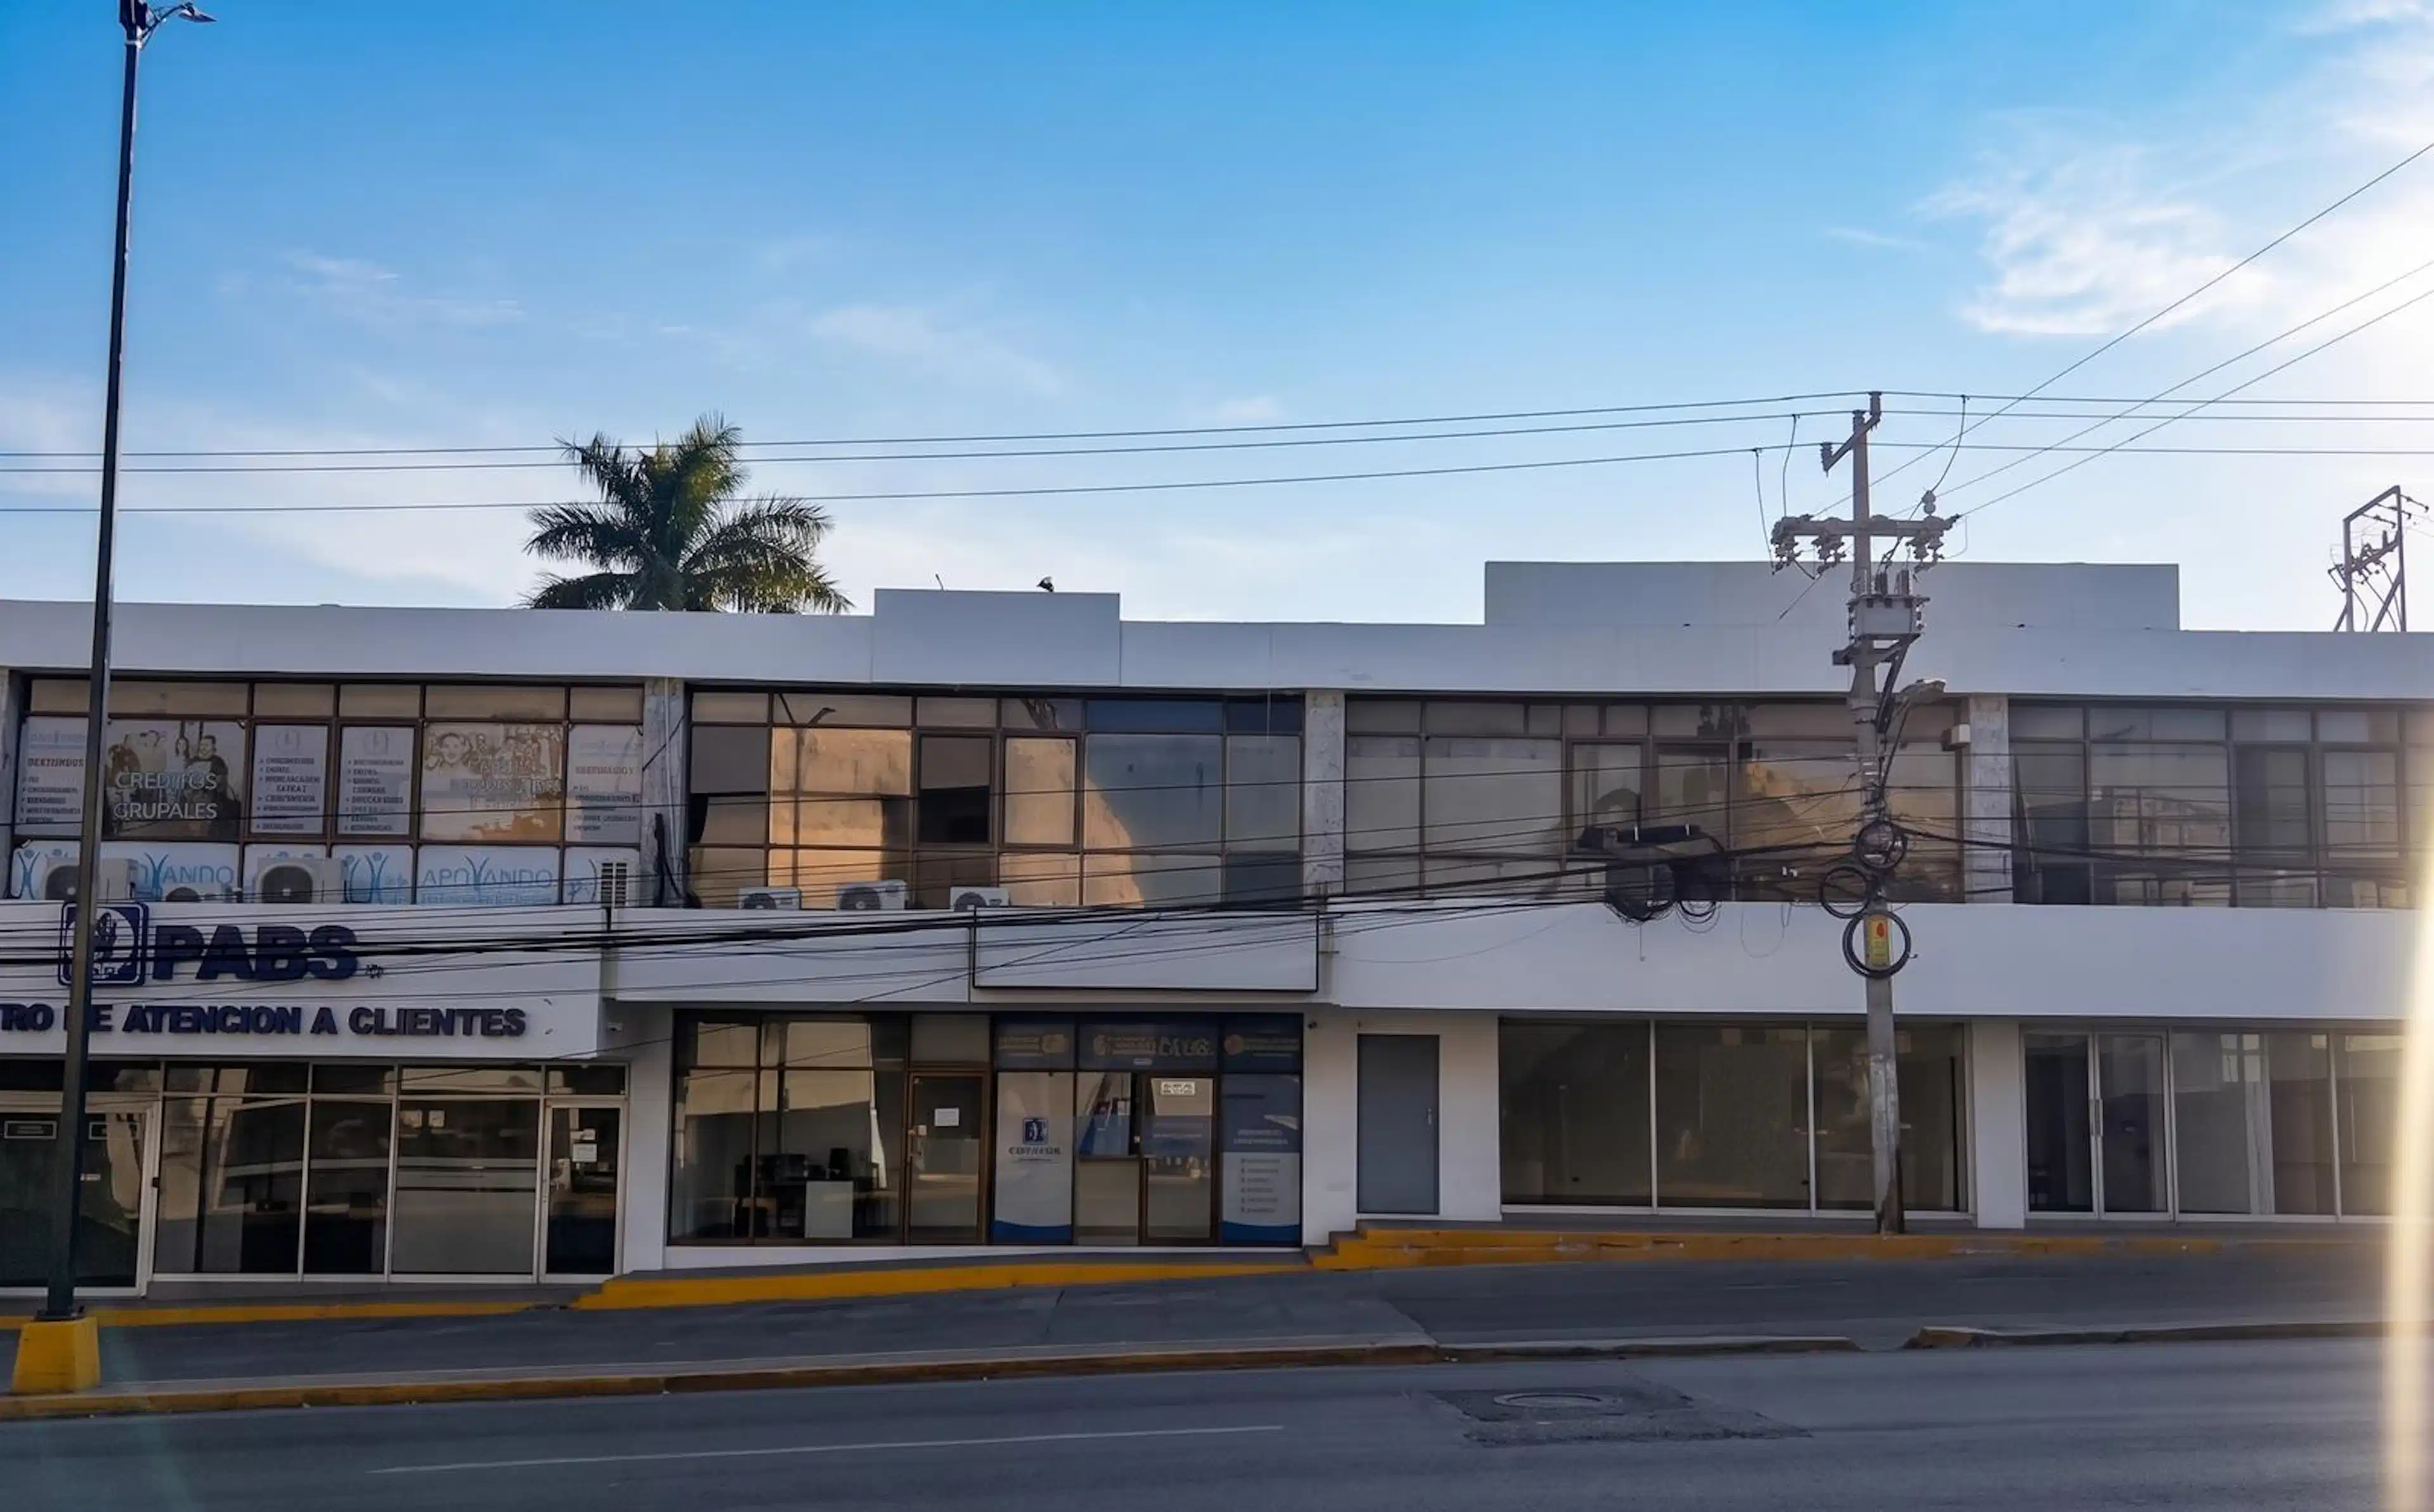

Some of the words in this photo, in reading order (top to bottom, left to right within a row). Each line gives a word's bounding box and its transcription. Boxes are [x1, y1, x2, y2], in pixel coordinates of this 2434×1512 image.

[113, 802, 218, 820] GRUPALES
[423, 854, 553, 888] APOYANDO
[153, 925, 357, 980] PABS
[0, 1003, 54, 1031] RO
[122, 1005, 300, 1035] ATENCION
[310, 1008, 337, 1035] A
[349, 1007, 525, 1037] CLIENTES
